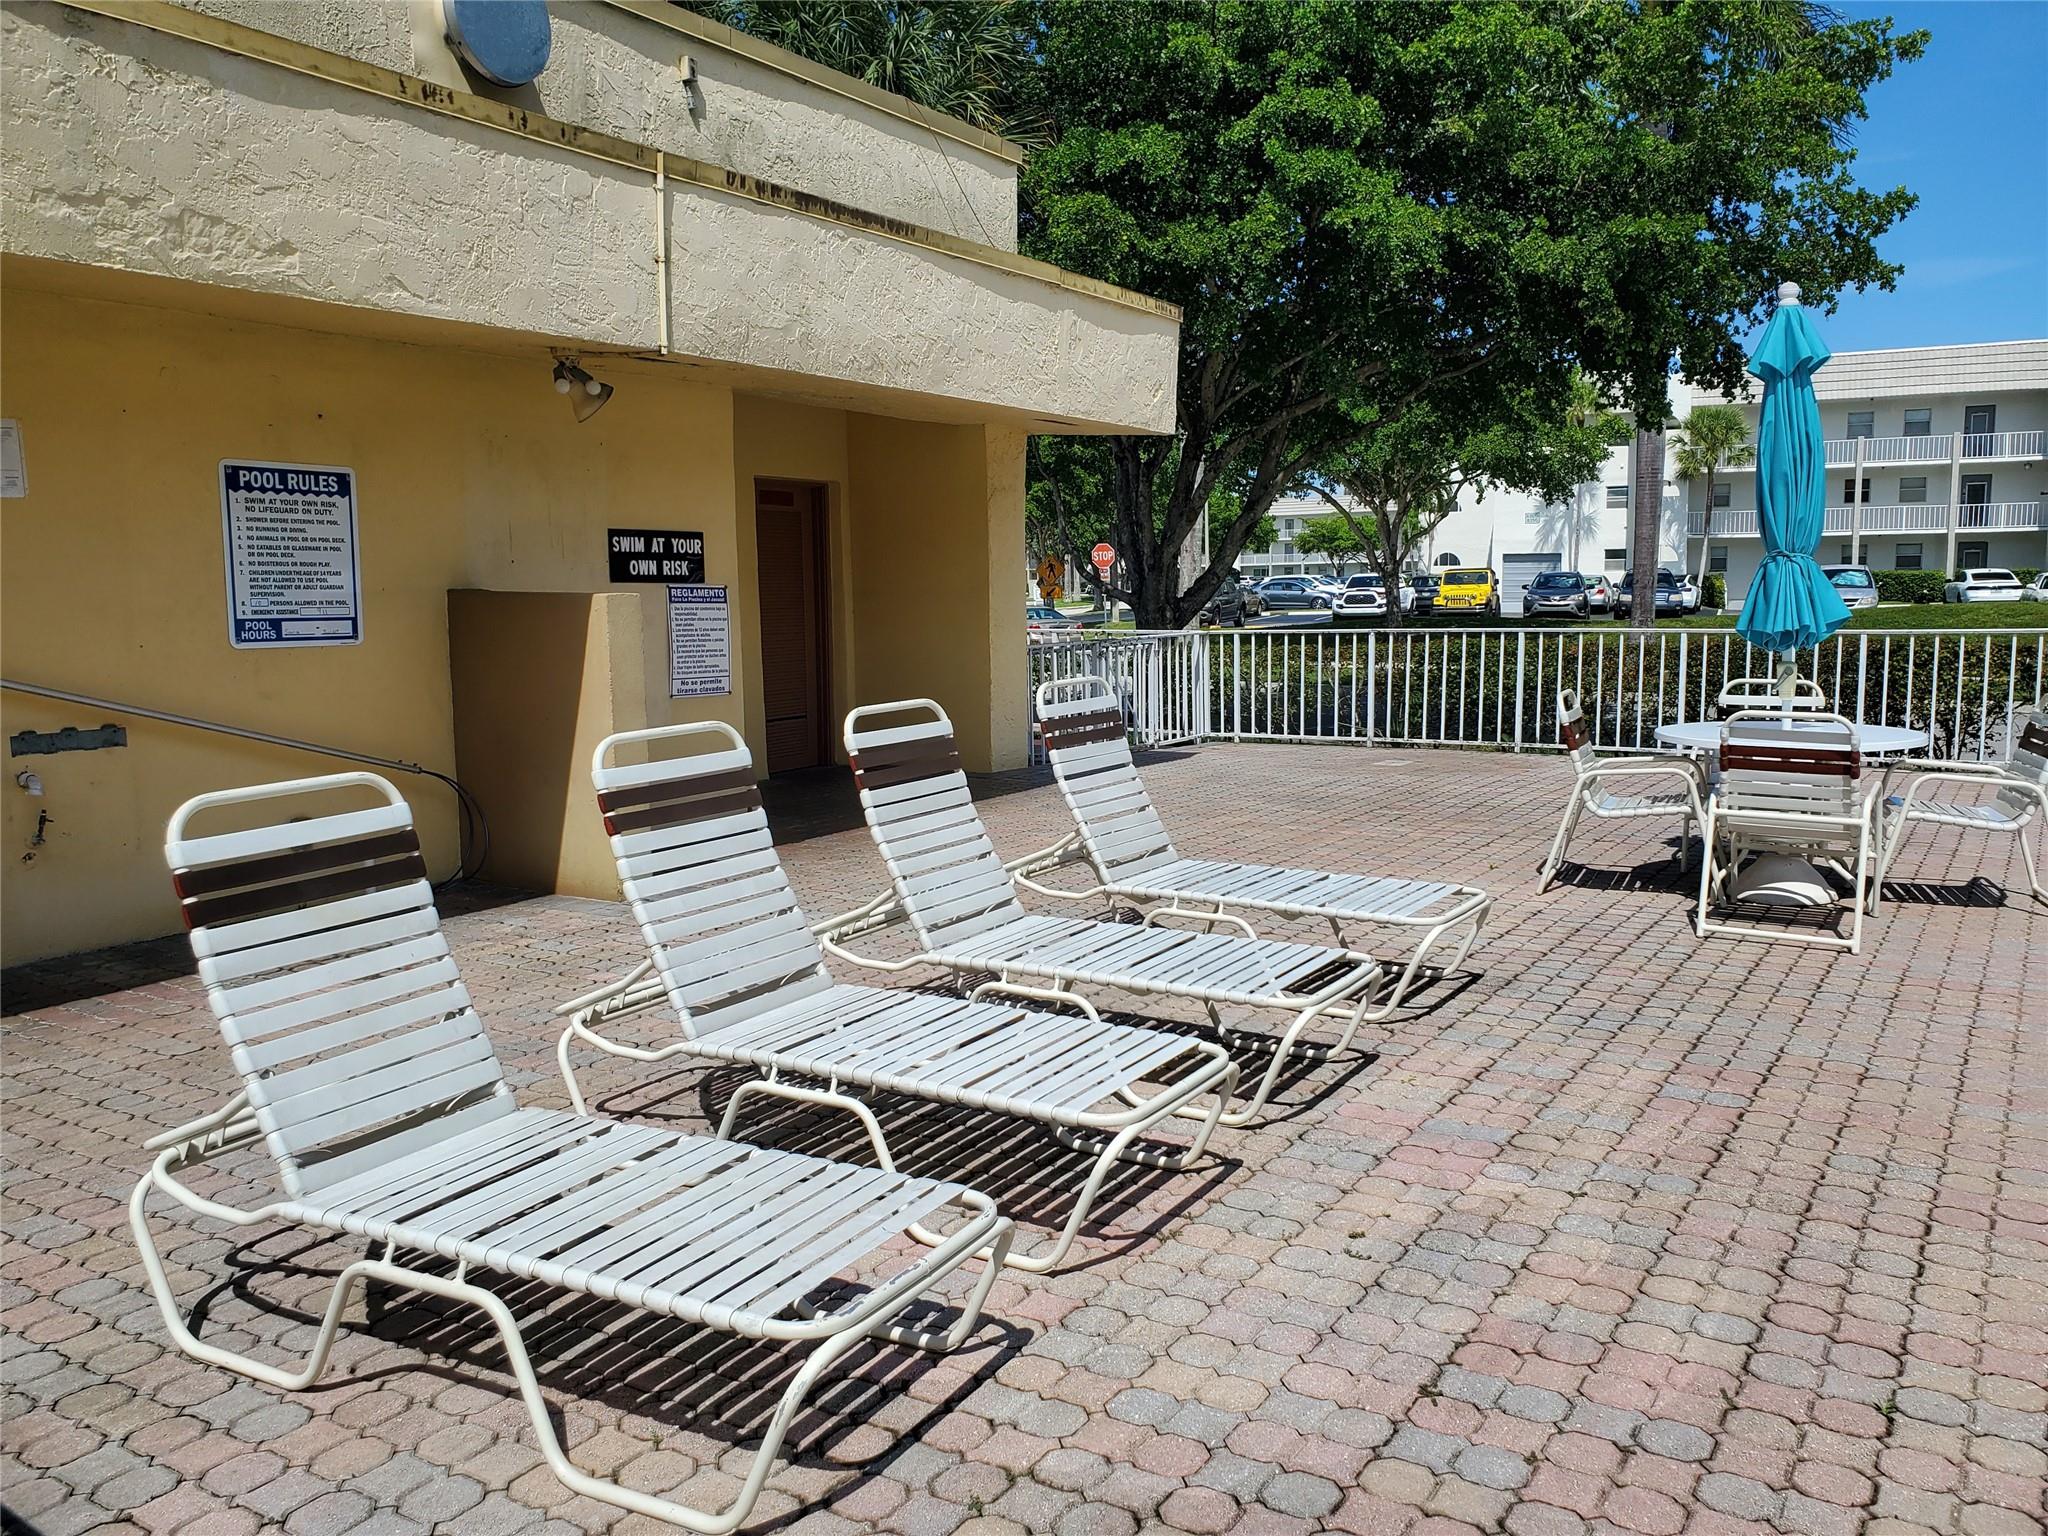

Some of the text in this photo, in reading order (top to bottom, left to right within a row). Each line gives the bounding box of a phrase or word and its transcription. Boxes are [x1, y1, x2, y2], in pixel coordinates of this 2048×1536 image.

[239, 470, 338, 492] POOL RULES
[258, 506, 299, 514] LIFEGUARD
[612, 536, 702, 554] SWIM AT YOUR
[1094, 552, 1112, 560] STOP
[630, 560, 688, 575] OWN RISK
[671, 589, 724, 597] REGLAMENTO
[245, 621, 272, 630] POOL
[241, 631, 276, 640] HOURS
